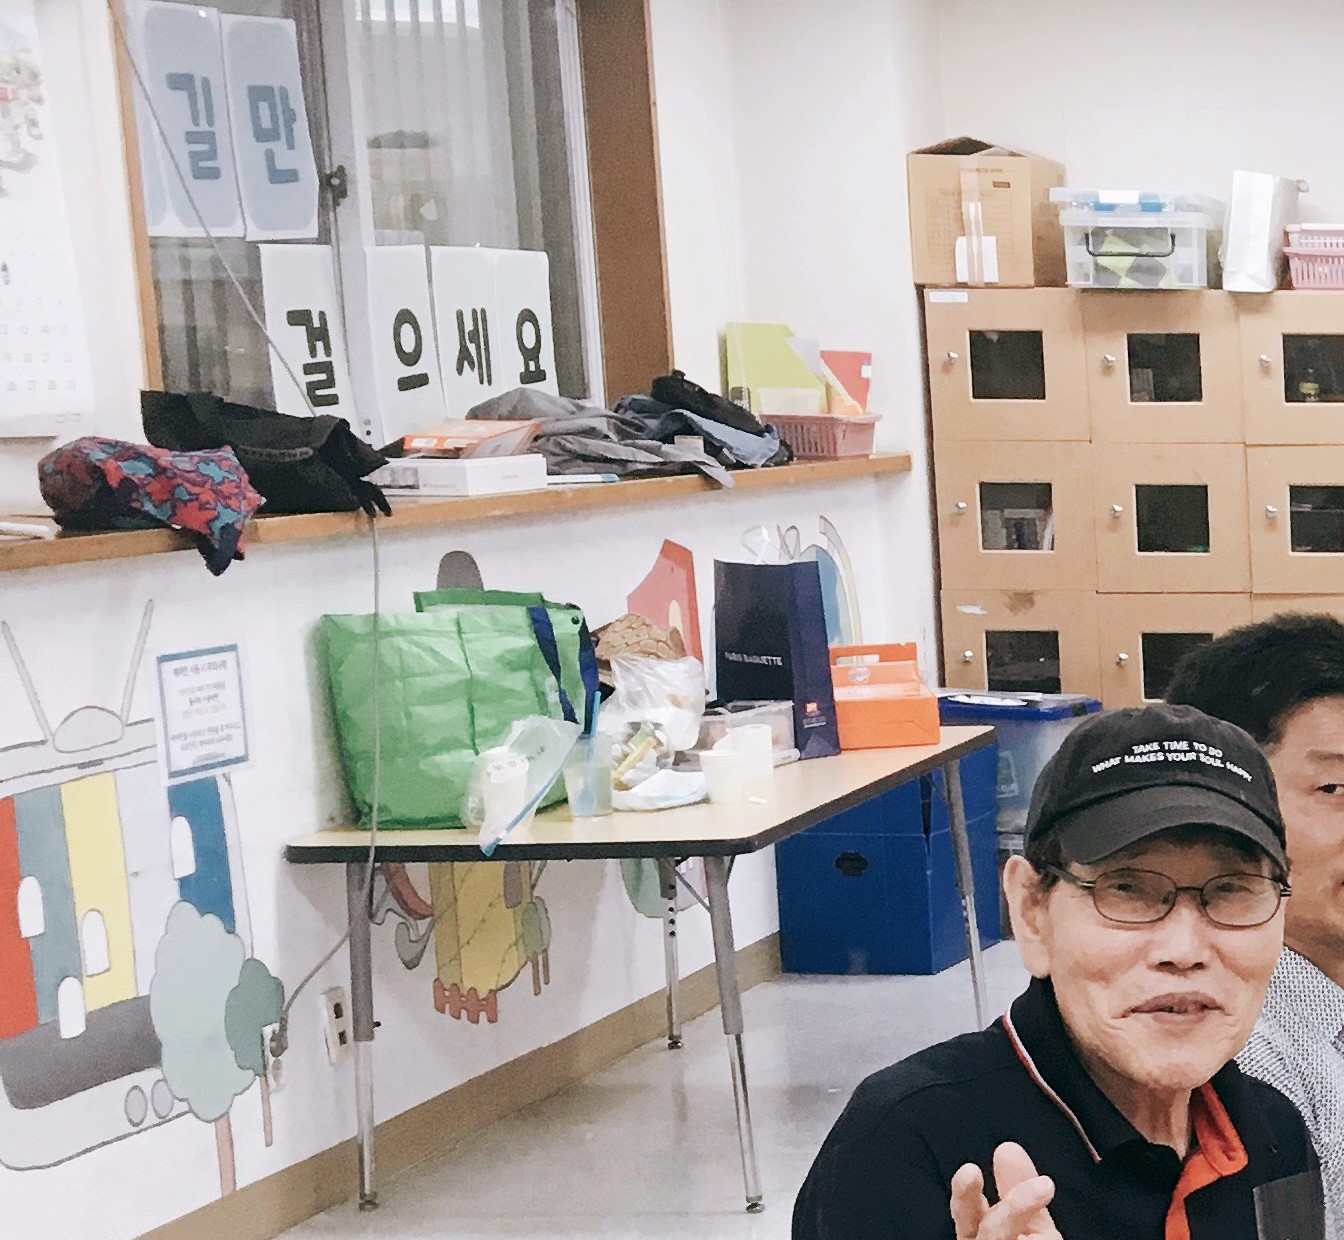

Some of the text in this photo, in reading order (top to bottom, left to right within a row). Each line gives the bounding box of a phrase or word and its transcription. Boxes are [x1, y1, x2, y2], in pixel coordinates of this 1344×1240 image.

[166, 73, 300, 185] 길만
[286, 308, 547, 407] 걸으세요
[1091, 752, 1253, 782] WHAT MAKES YOUR SOUL HAPPY
[1131, 740, 1223, 758] TAKE TIME TO DO
